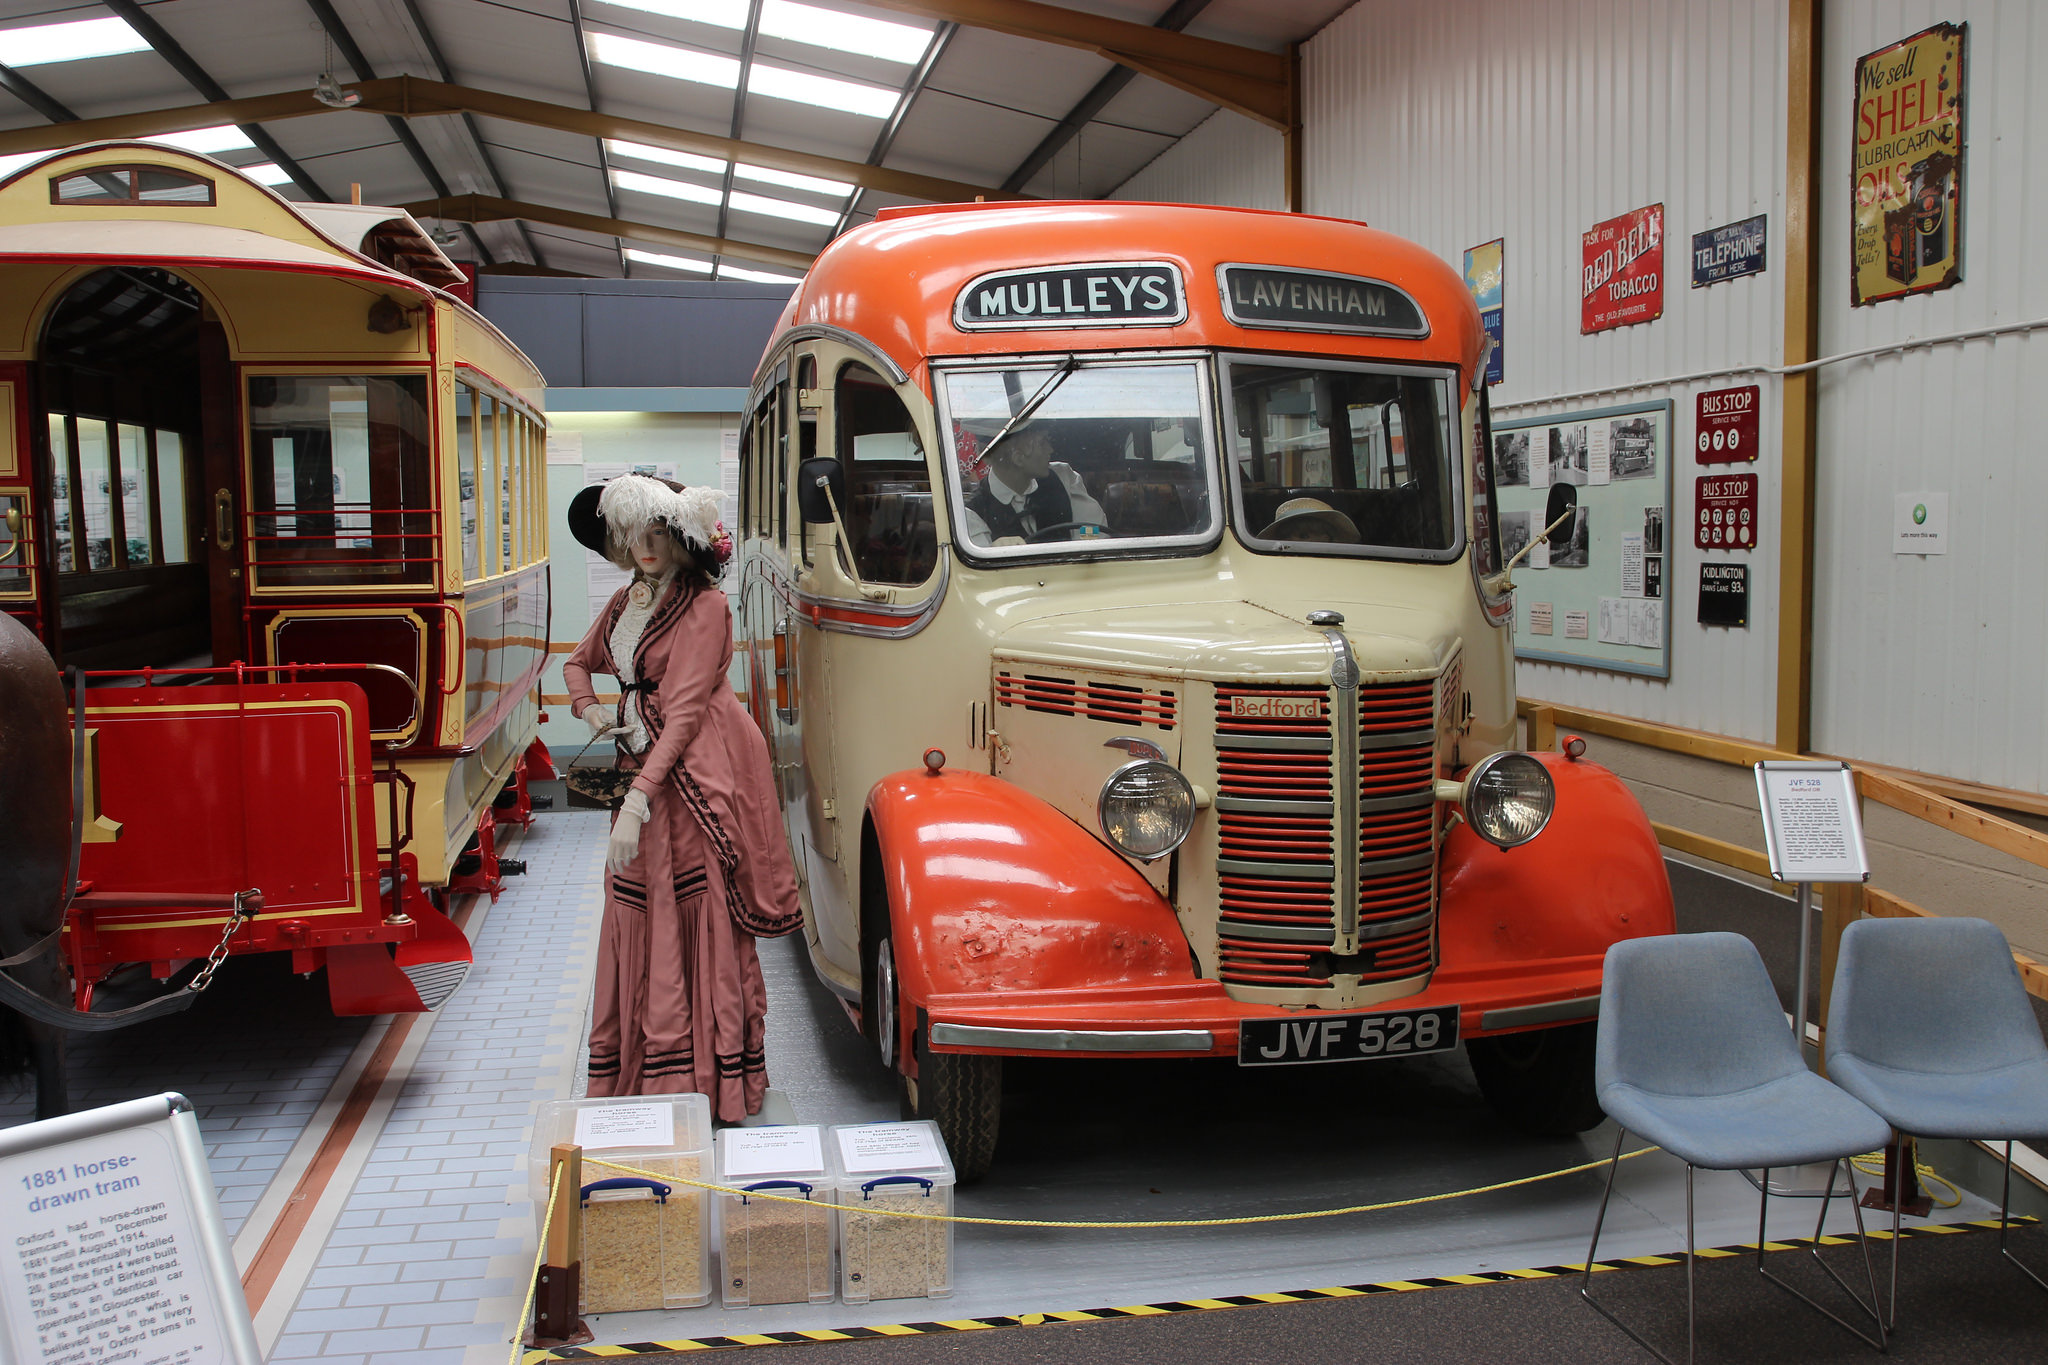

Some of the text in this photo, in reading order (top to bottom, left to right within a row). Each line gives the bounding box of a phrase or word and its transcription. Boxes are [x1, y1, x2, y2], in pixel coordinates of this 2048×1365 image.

[1864, 46, 1918, 94] We sell
[1859, 73, 1954, 145] SHELL
[1858, 123, 1953, 169] LUBRICATING
[1857, 161, 1908, 207] OILS
[1601, 228, 1614, 243] FOR
[1696, 234, 1762, 270] TELEPHONE
[1858, 238, 1876, 251] Drop
[1584, 214, 1660, 299] RED BELL
[1708, 260, 1747, 279] FROM HERE
[980, 275, 1169, 316] MULLEYS
[1234, 278, 1387, 317] LAVENHAM
[1608, 272, 1658, 302] TOBACCO
[1594, 303, 1647, 322] THE OLD FAVOURITE
[1703, 392, 1752, 414] BUS STOP
[1712, 416, 1729, 425] SERVICE
[1702, 433, 1736, 448] 6 7 8
[1703, 481, 1749, 497] BUS STOP
[1701, 530, 1722, 541] 70 74
[1703, 511, 1749, 522] 2 72 73 82
[1702, 584, 1716, 592] EVANS
[1703, 567, 1744, 579] KIDLINGTON
[1234, 698, 1318, 717] Bedford
[1260, 1013, 1441, 1059] JVF 528
[22, 1156, 137, 1191] 1881 horse-
[29, 1175, 141, 1213] drawn tram
[16, 1202, 165, 1246] Oxford had horse-drawn
[19, 1212, 168, 1258] tramcars from December
[23, 1230, 148, 1270] 1881 until August 1914.
[25, 1234, 174, 1283] The fleet eventually totalled
[48, 1277, 70, 1289] and
[72, 1272, 90, 1283] the
[92, 1264, 115, 1277] first
[126, 1254, 152, 1267] were
[154, 1246, 178, 1260] built
[31, 1258, 181, 1308] by Starbuck of Birkenhead.
[34, 1270, 184, 1319] This is an identical car
[38, 1289, 164, 1331] operated in Gloucester.
[57, 1330, 68, 1339] is
[77, 1314, 118, 1335] painted
[126, 1308, 138, 1318] in
[146, 1298, 172, 1312] what
[179, 1293, 190, 1302] is
[43, 1305, 193, 1357] believed to be the livery
[90, 1346, 104, 1356] by
[109, 1331, 146, 1349] Oxford
[151, 1322, 181, 1337] trams
[185, 1317, 196, 1326] in
